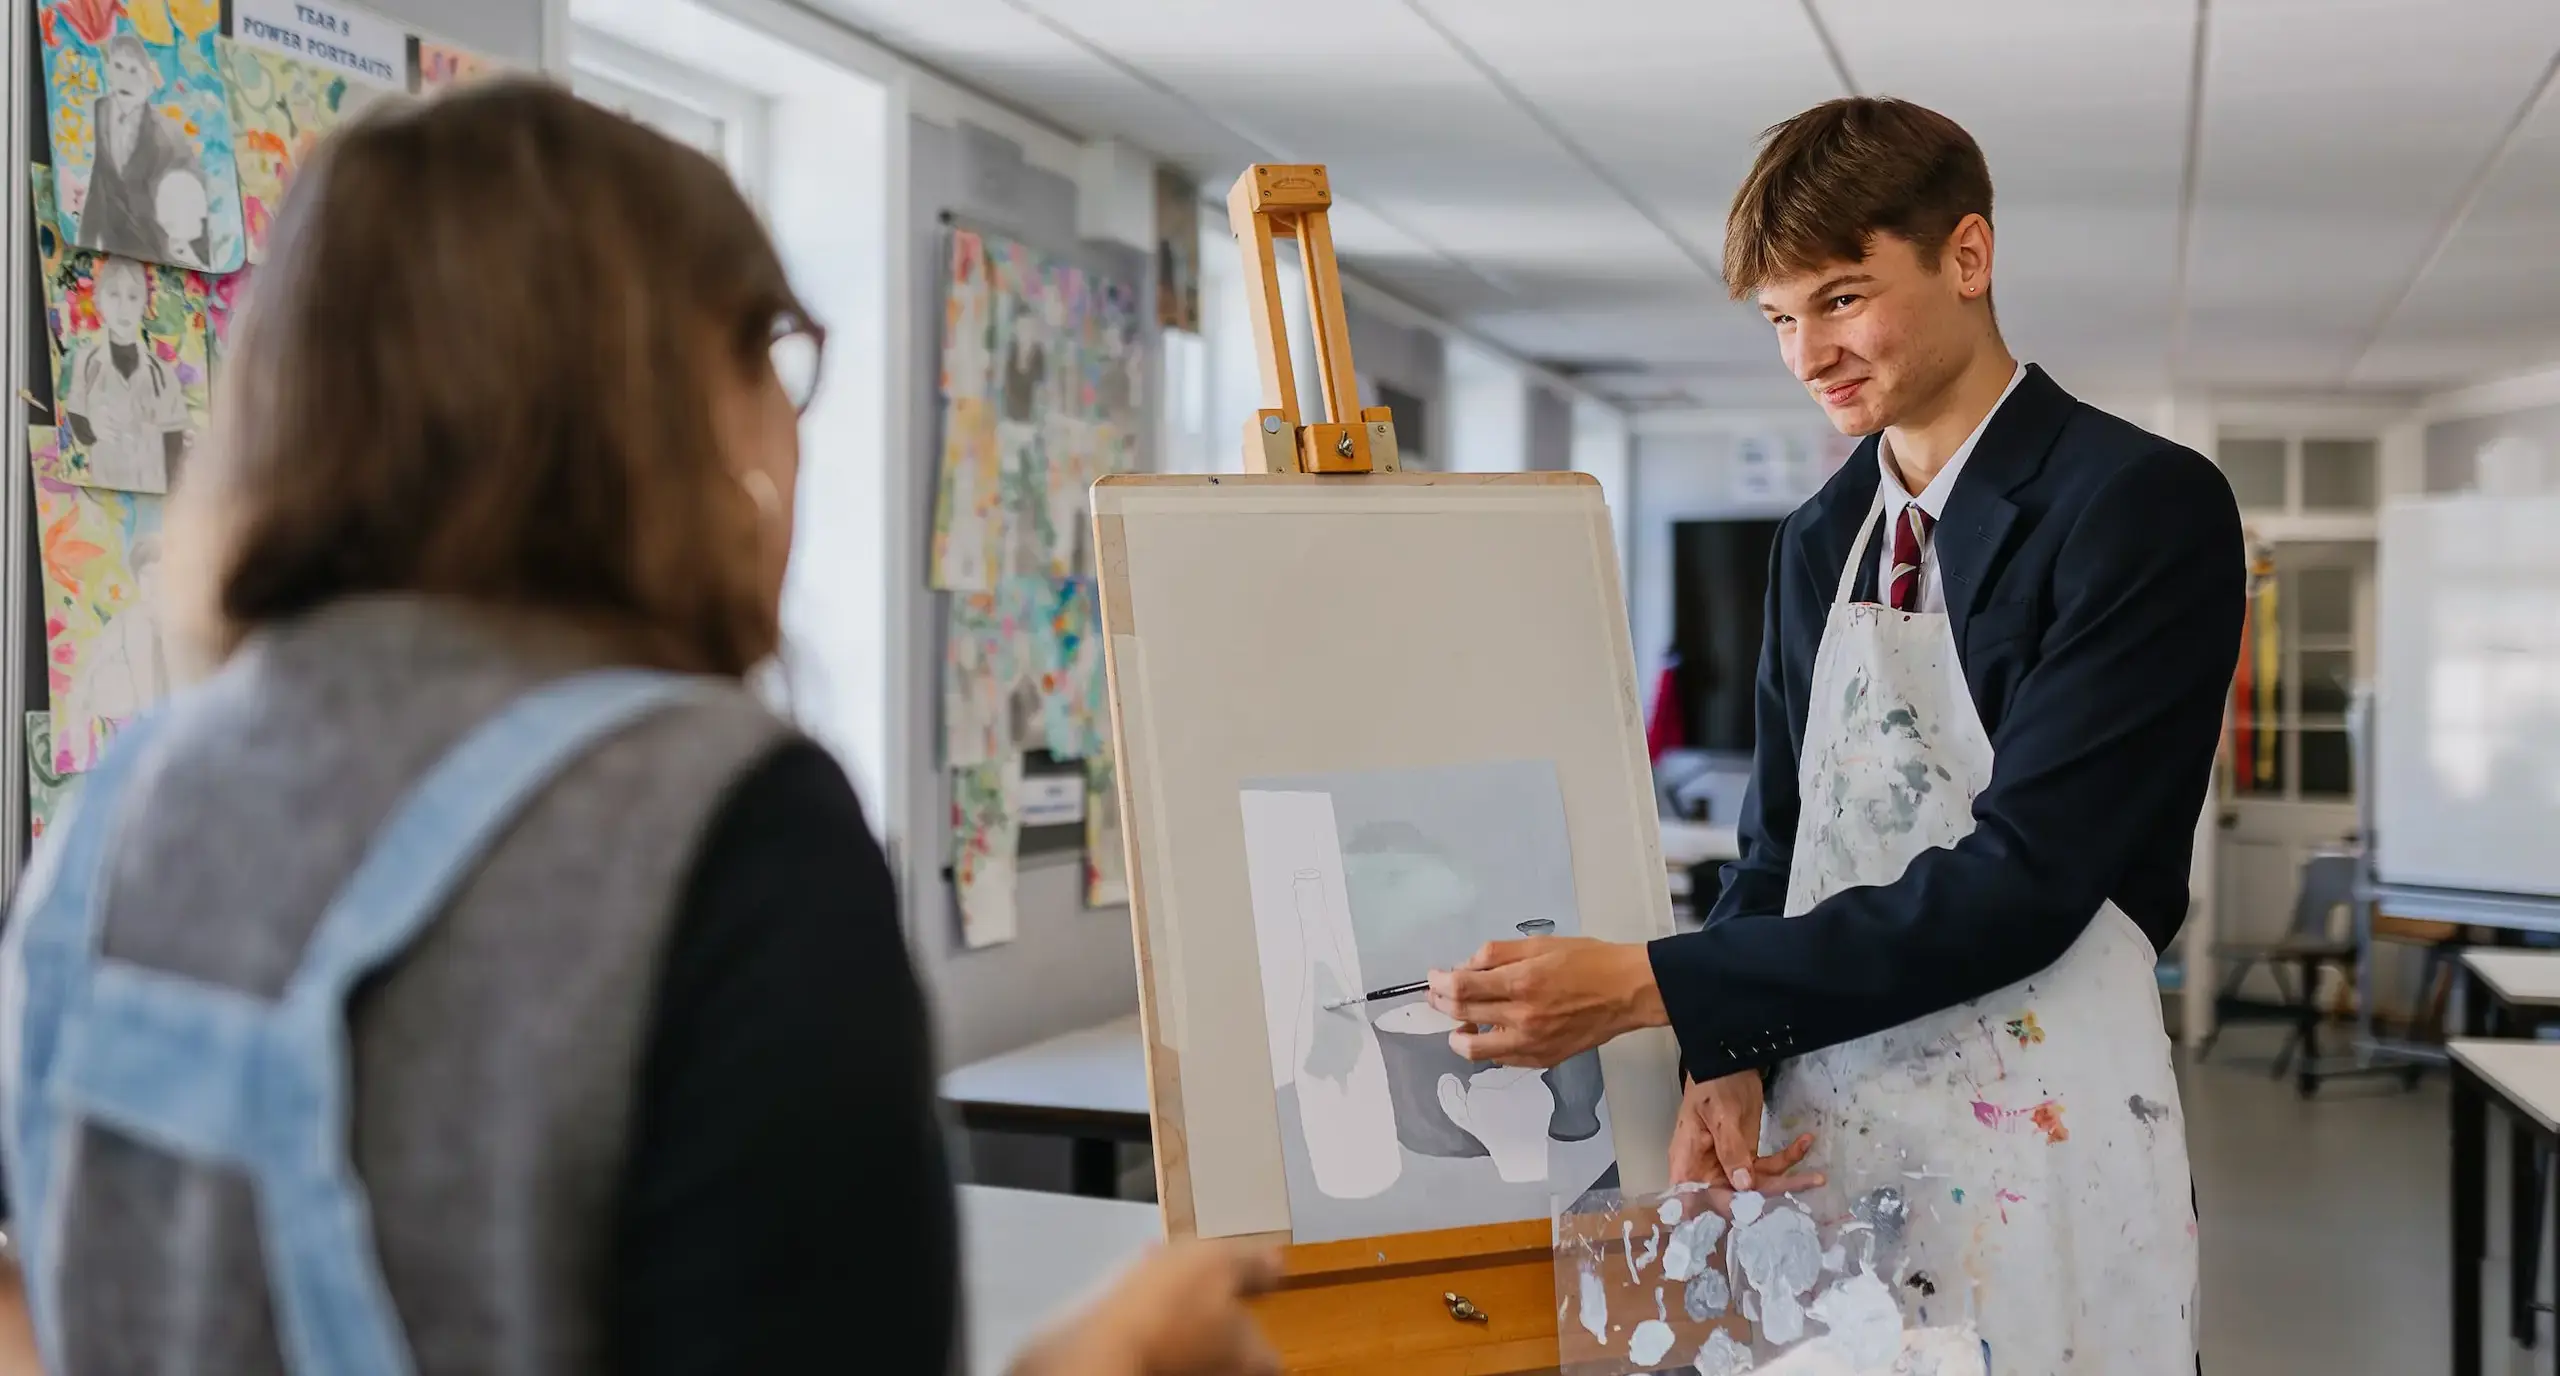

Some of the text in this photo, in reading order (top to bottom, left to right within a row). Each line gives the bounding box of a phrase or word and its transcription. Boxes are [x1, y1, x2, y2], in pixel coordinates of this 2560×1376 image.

[295, 4, 337, 33] YEAR
[243, 16, 394, 80] POWER PORTRAITS
